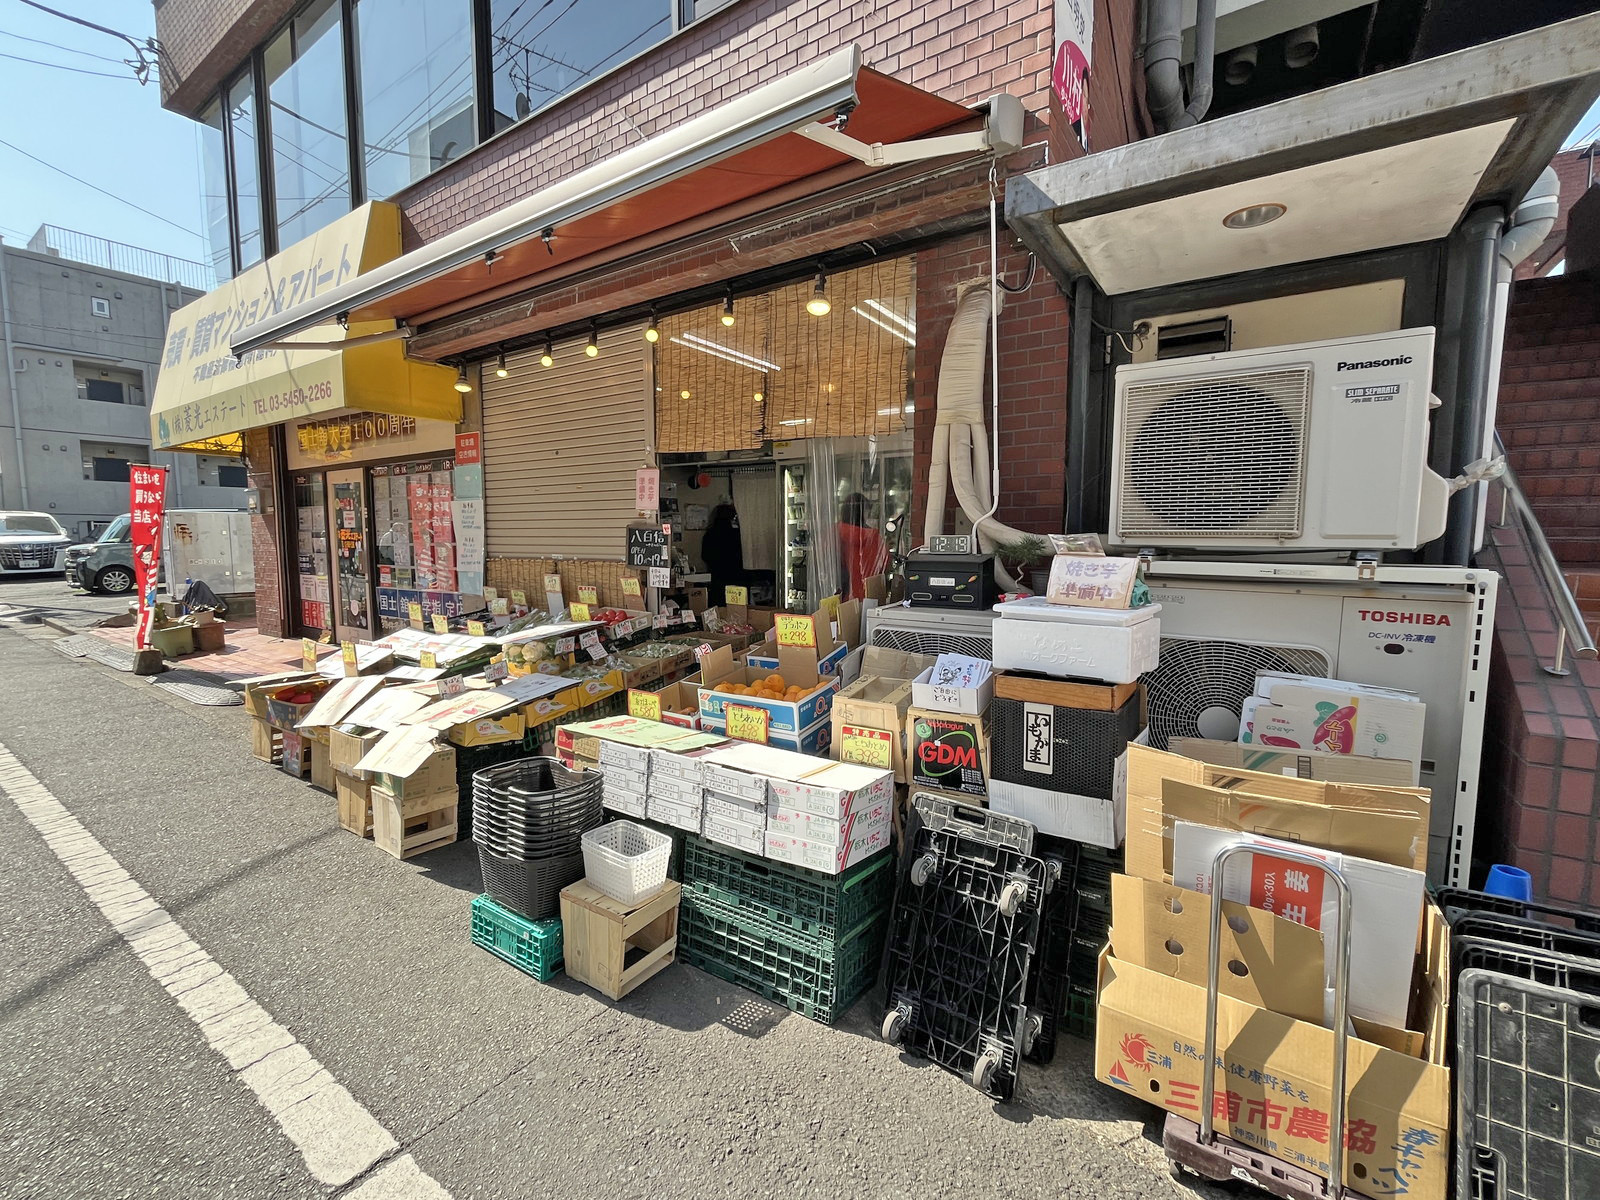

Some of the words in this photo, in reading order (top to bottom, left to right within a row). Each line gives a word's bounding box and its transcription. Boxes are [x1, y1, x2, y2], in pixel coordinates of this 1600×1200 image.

[1337, 355, 1413, 371] Panasonic
[254, 401, 268, 415] TEL
[269, 381, 332, 411] 03-5450-2266
[1347, 388, 1364, 397] SLIM
[1365, 386, 1398, 396] SEPARATE
[134, 471, 160, 485] 住まいを
[936, 537, 967, 552] 12:19
[1065, 560, 1120, 579] 焼き芋
[1060, 581, 1113, 601] 準備中
[1358, 610, 1451, 626] TOSHIBA
[789, 631, 807, 641] 298
[1368, 632, 1400, 641] DC-INV
[1401, 633, 1437, 644] 冷凍機
[739, 723, 760, 737] 498
[852, 728, 881, 740] 特売品
[1028, 714, 1051, 761] いもがま
[855, 748, 880, 764] 398
[918, 741, 977, 769] GDM
[1147, 1050, 1173, 1070] 三浦
[1233, 1125, 1278, 1152] 神奈川県
[1283, 1146, 1330, 1173] 三浦半島
[1372, 1126, 1440, 1194] 春キャベツ
